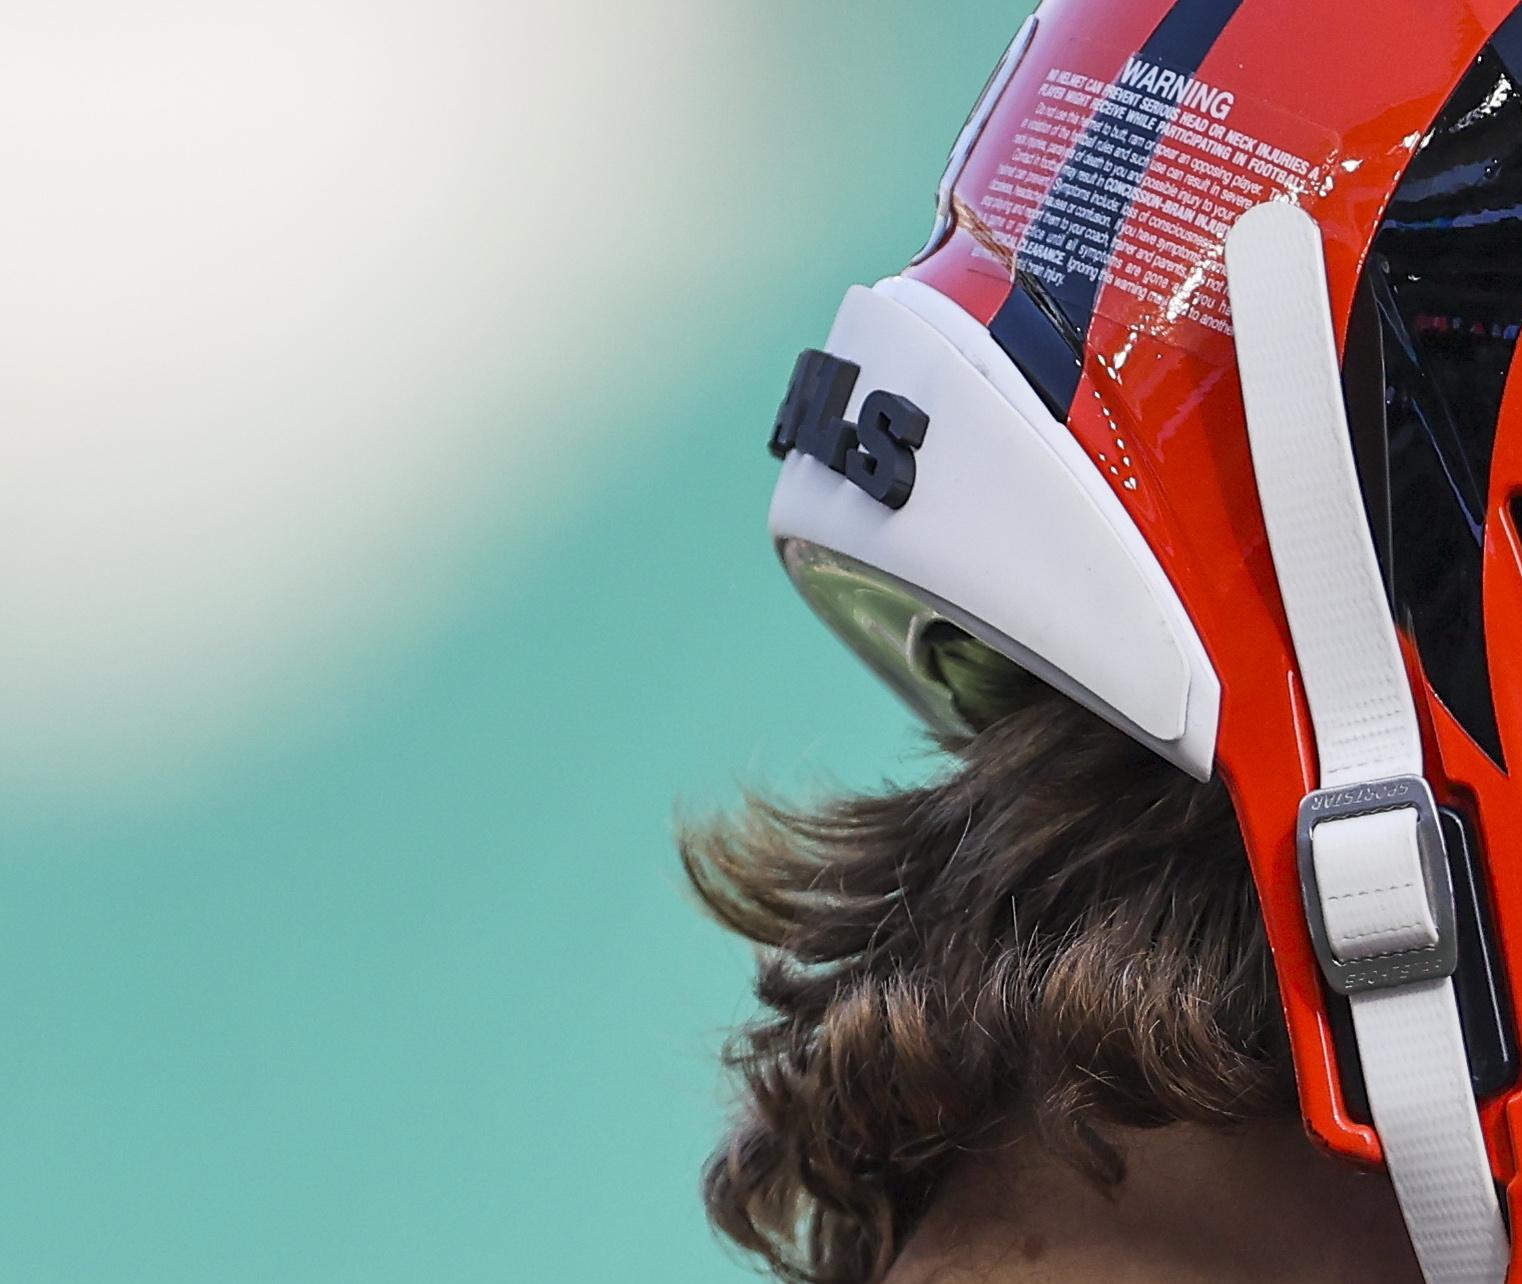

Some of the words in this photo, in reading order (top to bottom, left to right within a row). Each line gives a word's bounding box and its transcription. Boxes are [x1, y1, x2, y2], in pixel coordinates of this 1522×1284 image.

[1121, 58, 1234, 120] WARNING
[1068, 113, 1080, 123] this
[1103, 125, 1110, 134] to
[1112, 127, 1128, 141] butt,
[1129, 136, 1144, 145] ram
[1153, 147, 1179, 163] spear
[1179, 154, 1190, 162] an
[1190, 159, 1232, 183] opposing
[1231, 176, 1263, 196] player.
[1086, 80, 1103, 93] CAN
[1103, 86, 1141, 106] PREVENT
[1140, 99, 1180, 120] SERIOUS
[1180, 115, 1207, 131] HEAD
[1210, 126, 1224, 138] OR
[1226, 133, 1256, 151] NECK
[1256, 145, 1309, 173] INJURIES
[1309, 168, 1321, 179] A
[1090, 99, 1125, 118] RECEIVE
[1126, 112, 1156, 129] WHILE
[1156, 123, 1232, 159] PARTICIPATING
[1234, 154, 1246, 164] IN
[1053, 179, 1091, 202] Symptoms
[1121, 205, 1138, 217] loss
[1139, 211, 1149, 221] of
[1061, 167, 1076, 179] may
[1077, 170, 1097, 183] result
[1096, 178, 1104, 186] in
[1104, 180, 1195, 221] CONCUSSION-BRAIN
[1083, 154, 1104, 168] death
[1104, 162, 1112, 171] to
[1111, 167, 1127, 179] you
[1128, 171, 1143, 182] and
[1142, 178, 1178, 198] possible
[1177, 192, 1202, 209] injury
[1203, 201, 1213, 210] to
[1213, 207, 1234, 221] your
[1096, 140, 1114, 153] rules
[1115, 146, 1130, 158] and
[1131, 152, 1149, 165] such
[1150, 161, 1167, 173] use
[1167, 168, 1184, 179] can
[1185, 174, 1210, 190] result
[1211, 185, 1220, 194] in
[1220, 191, 1253, 209] severe
[1044, 214, 1060, 225] them
[1061, 219, 1069, 228] to
[1068, 225, 1085, 237] your
[1085, 228, 1110, 245] coach,
[1111, 238, 1137, 254] trainer
[1137, 248, 1154, 261] and
[1206, 279, 1224, 291] not
[1068, 205, 1076, 213] or
[1115, 220, 1122, 229] If
[1120, 226, 1136, 238] you
[1137, 230, 1157, 242] have
[1043, 268, 1065, 285] injury.
[1047, 232, 1064, 245] until
[1067, 239, 1077, 249] all
[1079, 246, 1122, 269] symptoms
[1125, 265, 1141, 275] are
[1144, 272, 1168, 288] gone
[1066, 258, 1099, 280] Ignoring
[1099, 271, 1113, 283] this
[1113, 279, 1147, 300] warning
[1189, 309, 1200, 319] to
[1311, 785, 1409, 811] SPORTSTAR
